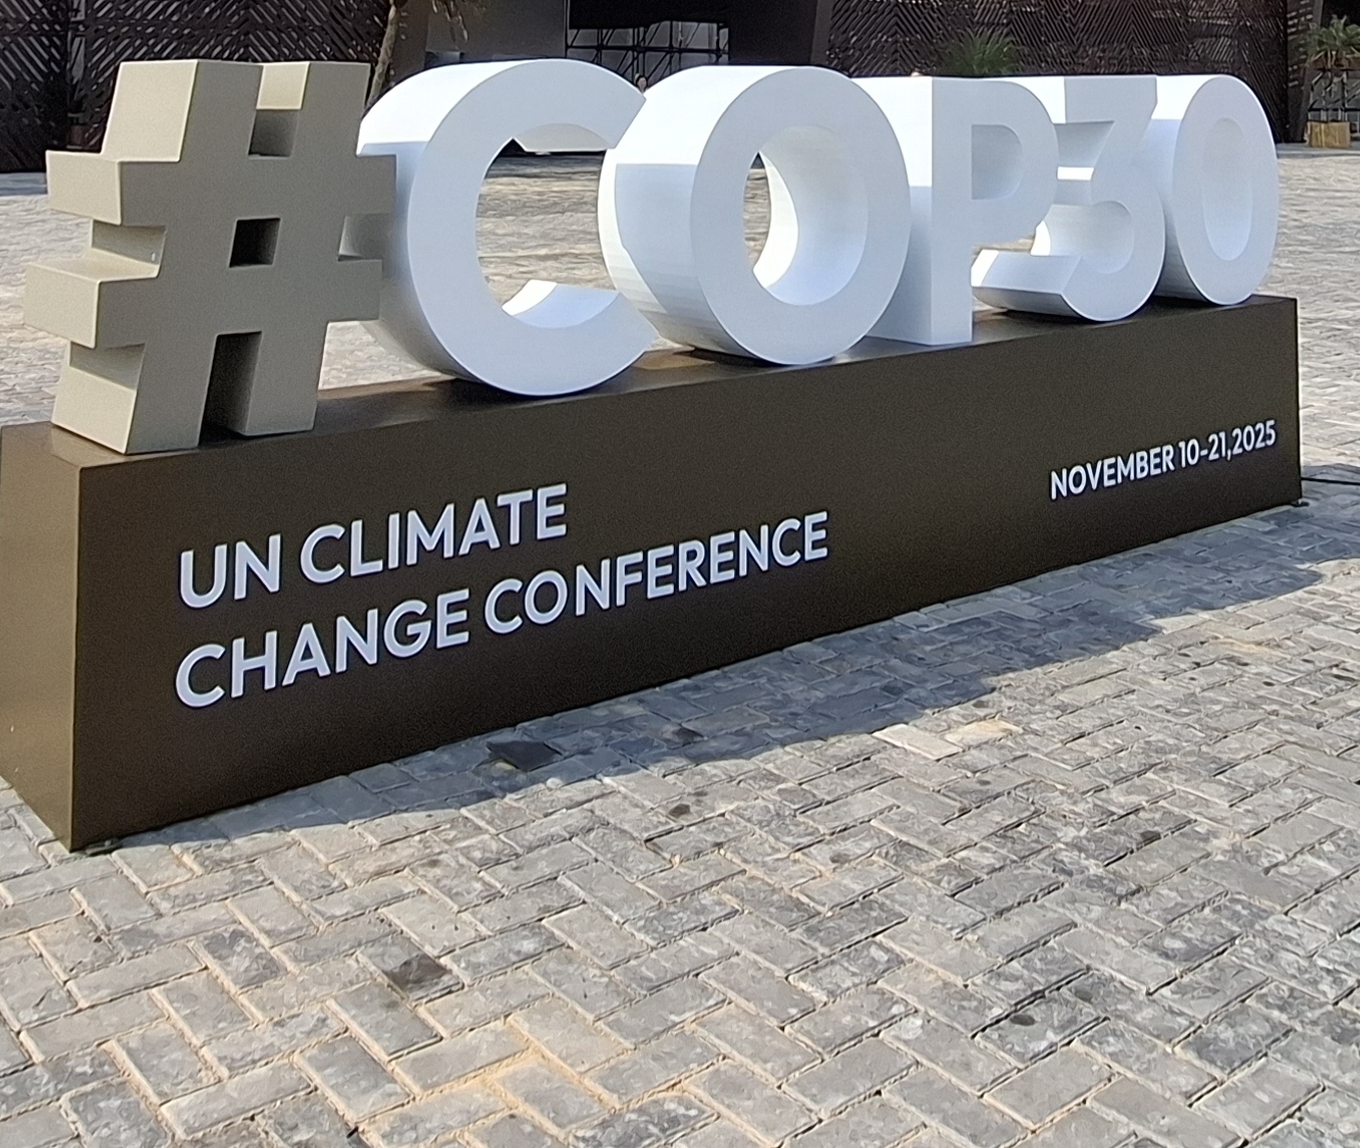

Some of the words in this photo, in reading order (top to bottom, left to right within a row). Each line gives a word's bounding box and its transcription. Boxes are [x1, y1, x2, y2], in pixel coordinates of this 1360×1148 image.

[1051, 444, 1175, 500] NOVEMBER
[1178, 419, 1276, 468] 10-21,2025
[175, 588, 470, 708] CHANGE
[483, 510, 829, 635] CONFERENCE
[179, 533, 282, 609] UN
[299, 483, 568, 584] CLIMATE
